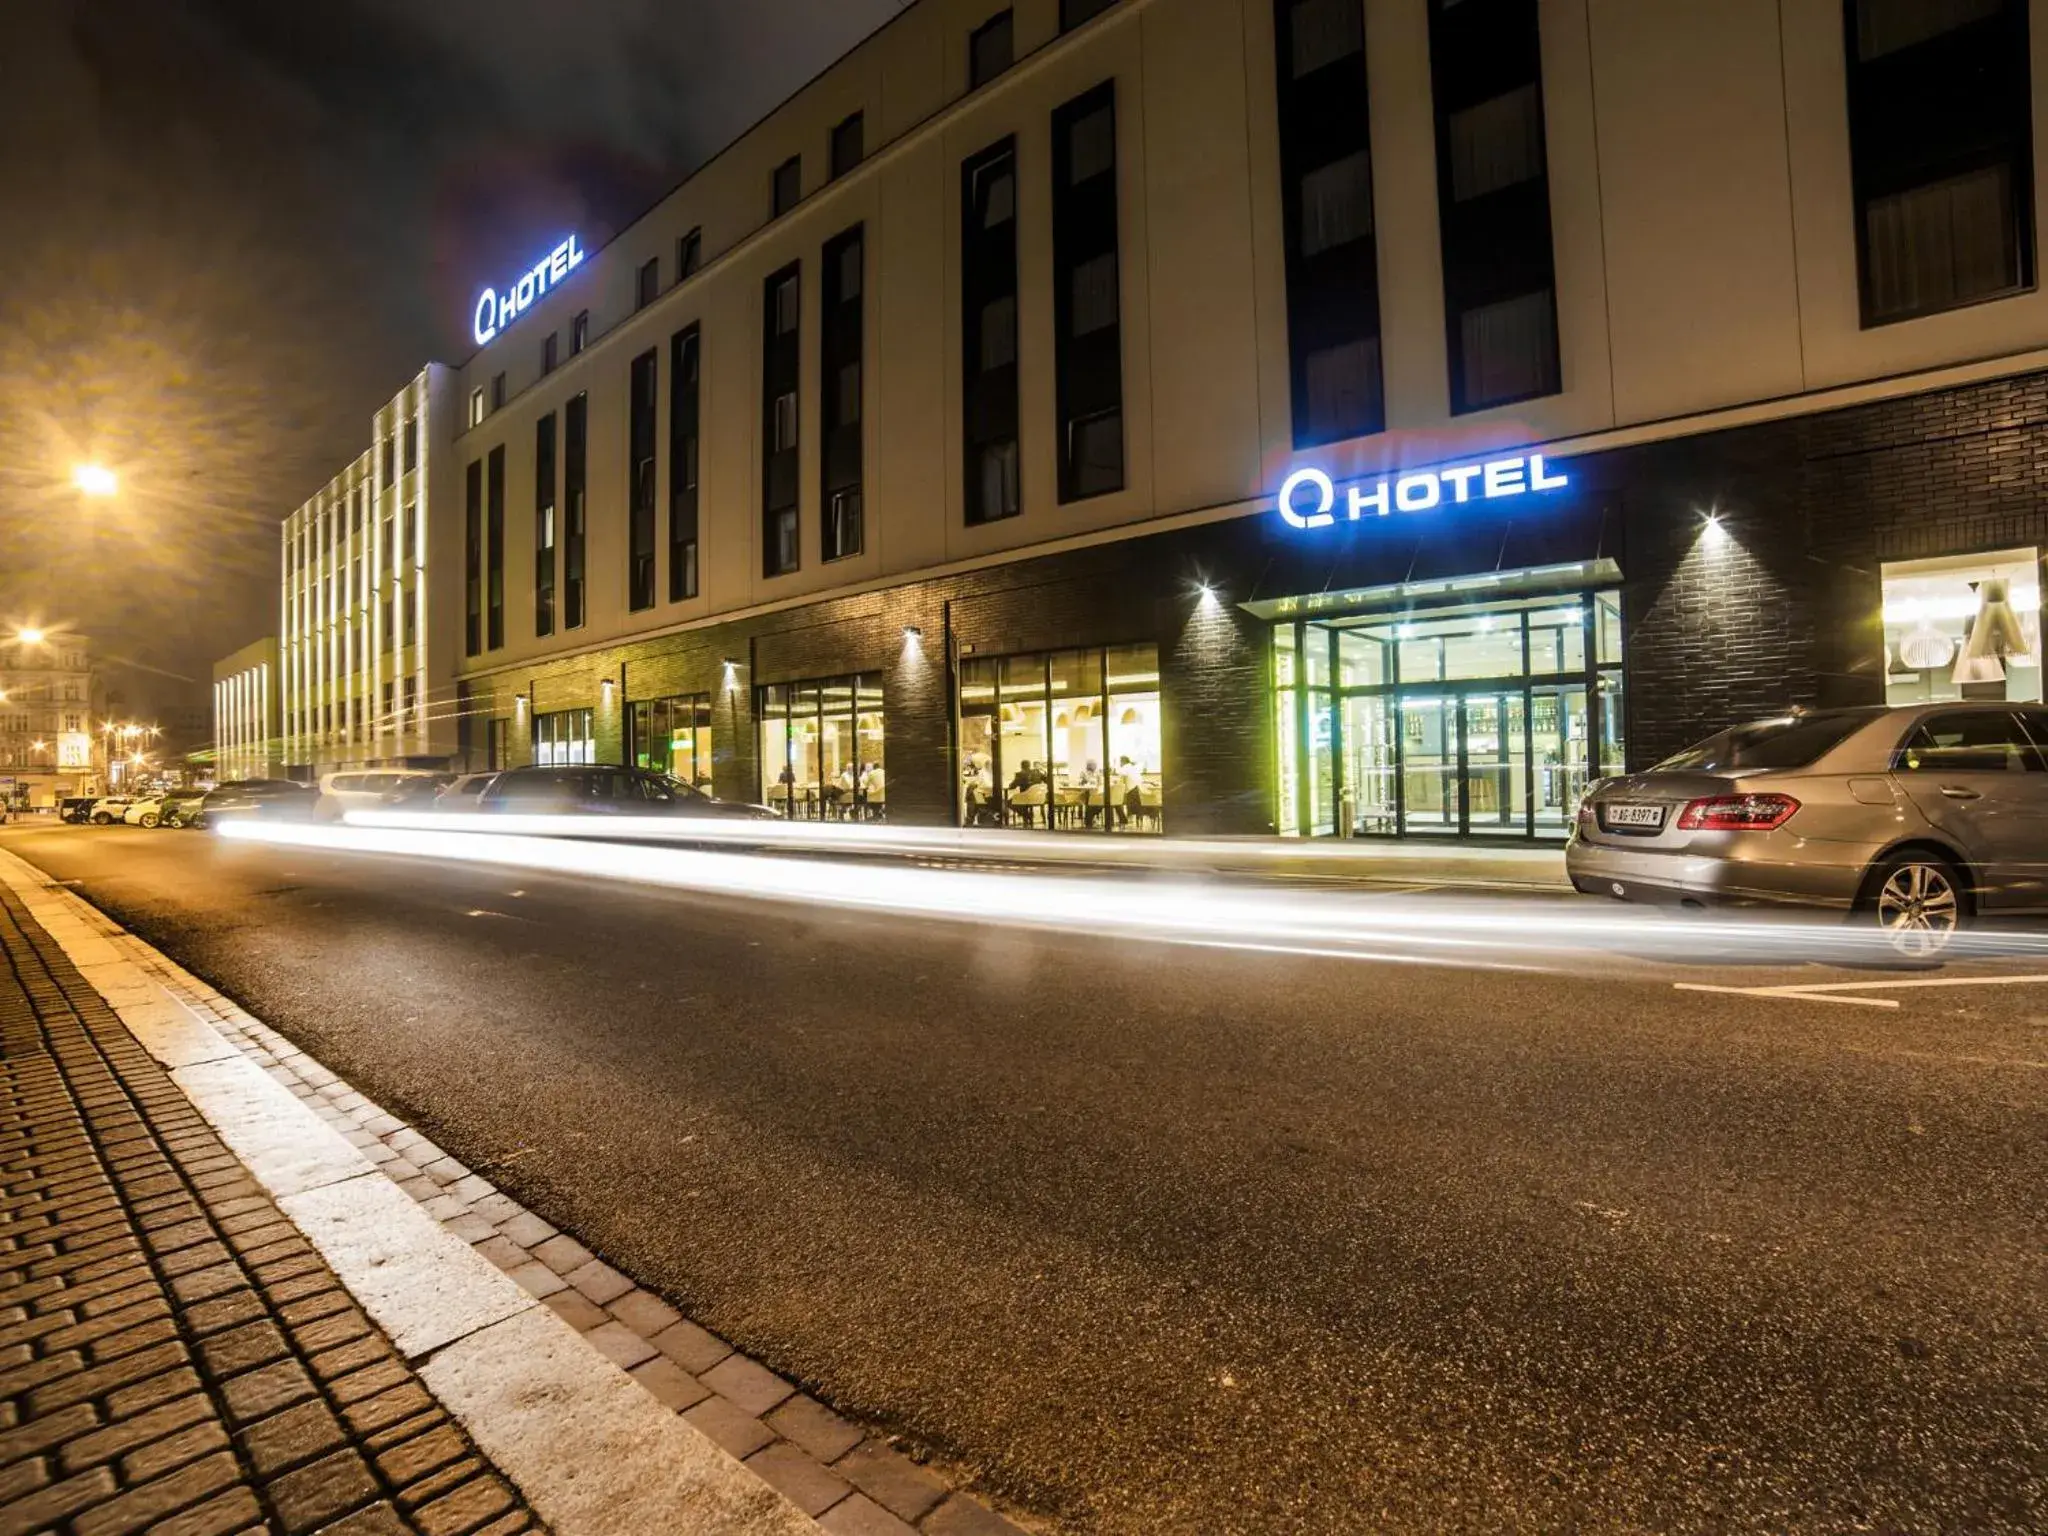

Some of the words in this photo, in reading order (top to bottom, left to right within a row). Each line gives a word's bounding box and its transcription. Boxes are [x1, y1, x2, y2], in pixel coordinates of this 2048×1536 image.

[474, 287, 497, 344] Q
[499, 234, 584, 328] HOTEL
[1278, 467, 1334, 529] Q
[1347, 453, 1568, 521] HOTEL
